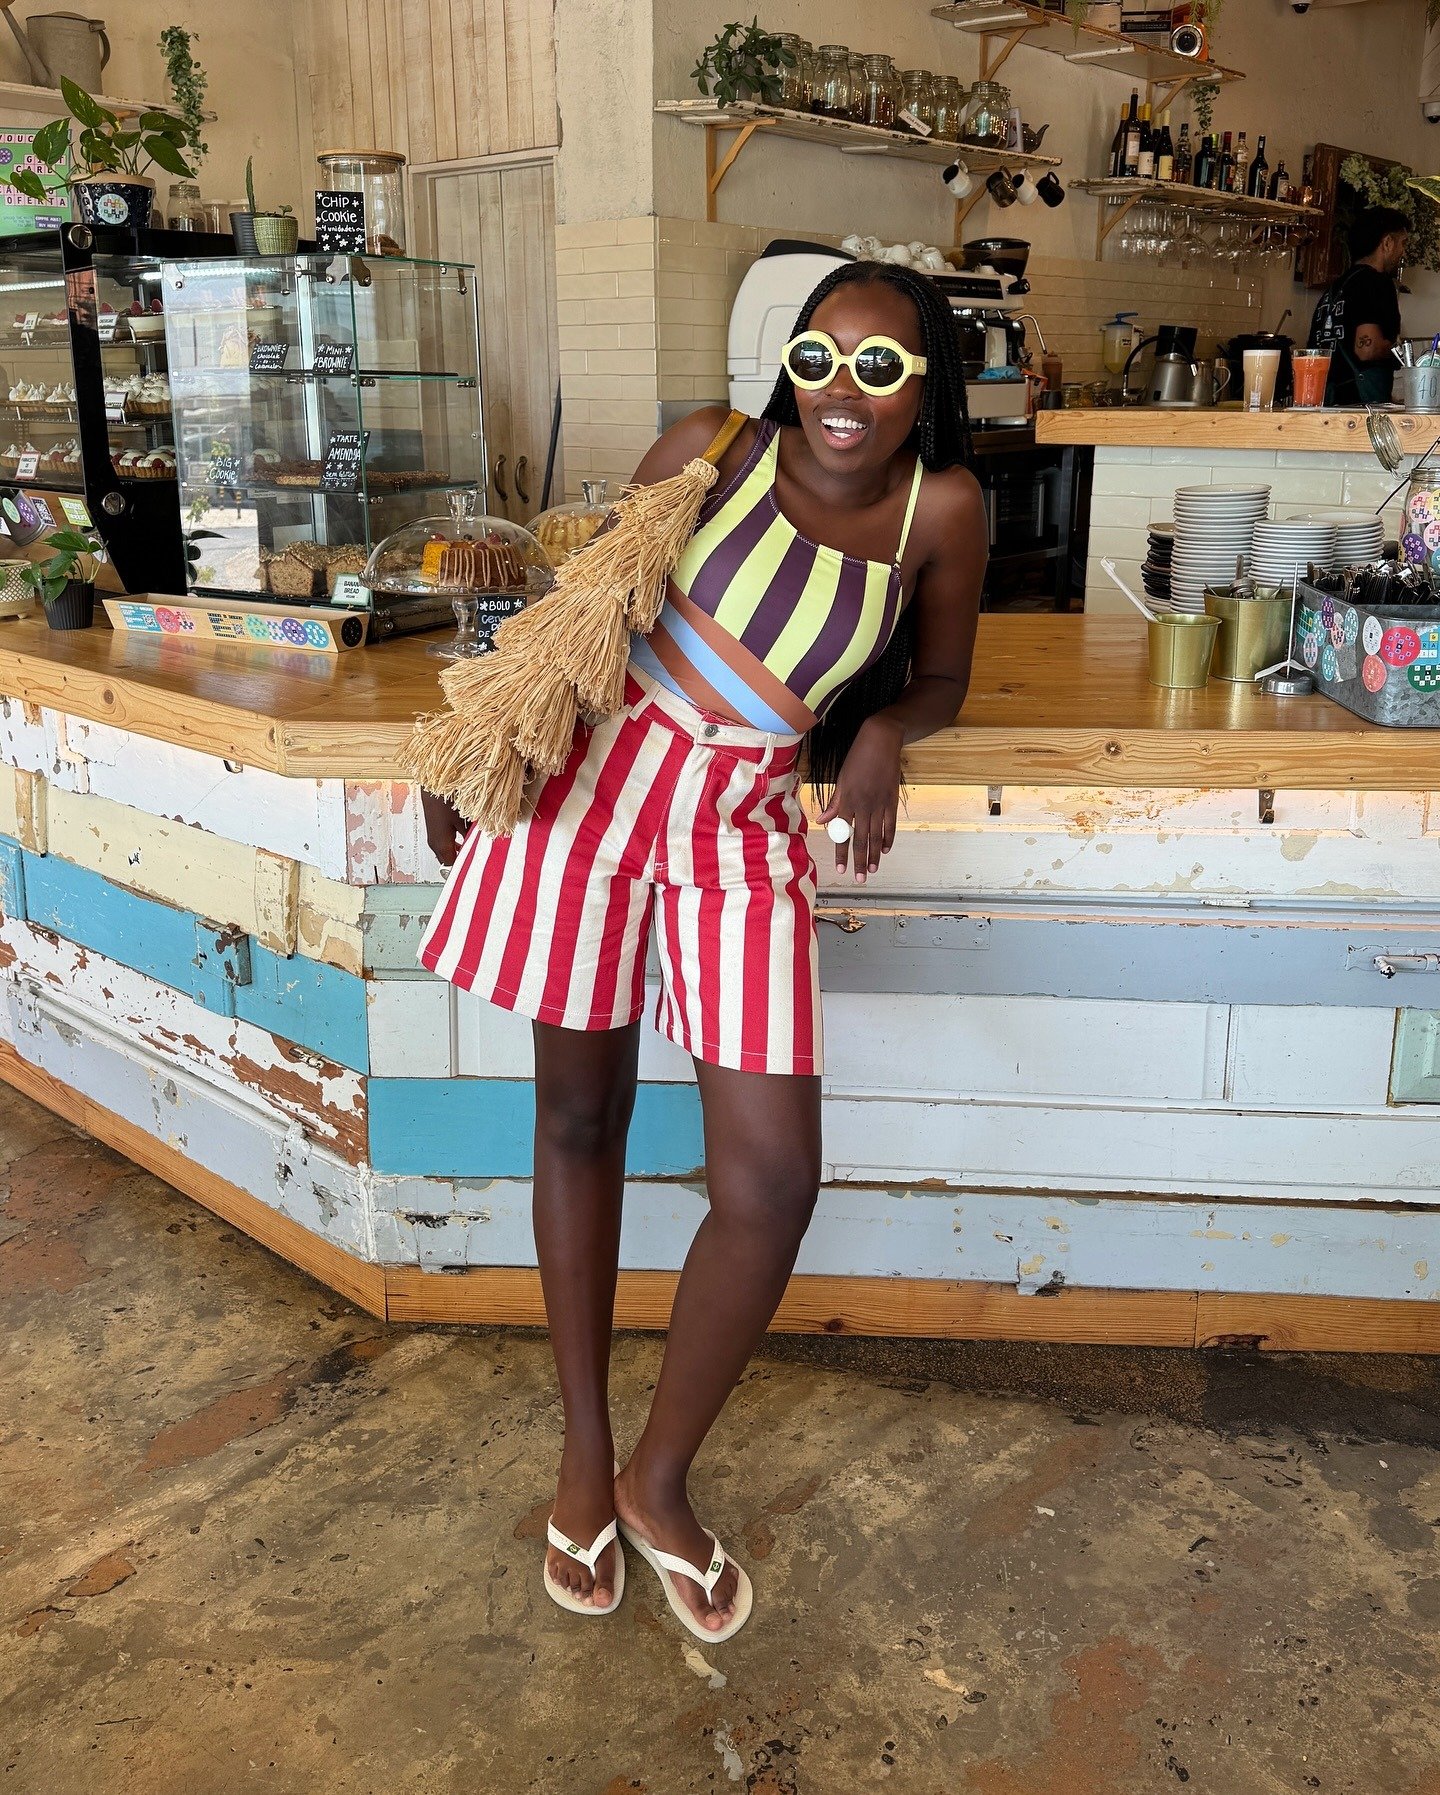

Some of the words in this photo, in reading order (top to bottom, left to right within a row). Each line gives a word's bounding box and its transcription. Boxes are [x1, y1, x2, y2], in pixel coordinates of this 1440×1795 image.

[336, 434, 358, 443] TARTE
[216, 457, 232, 468] BIG
[489, 600, 511, 611] BOLO
